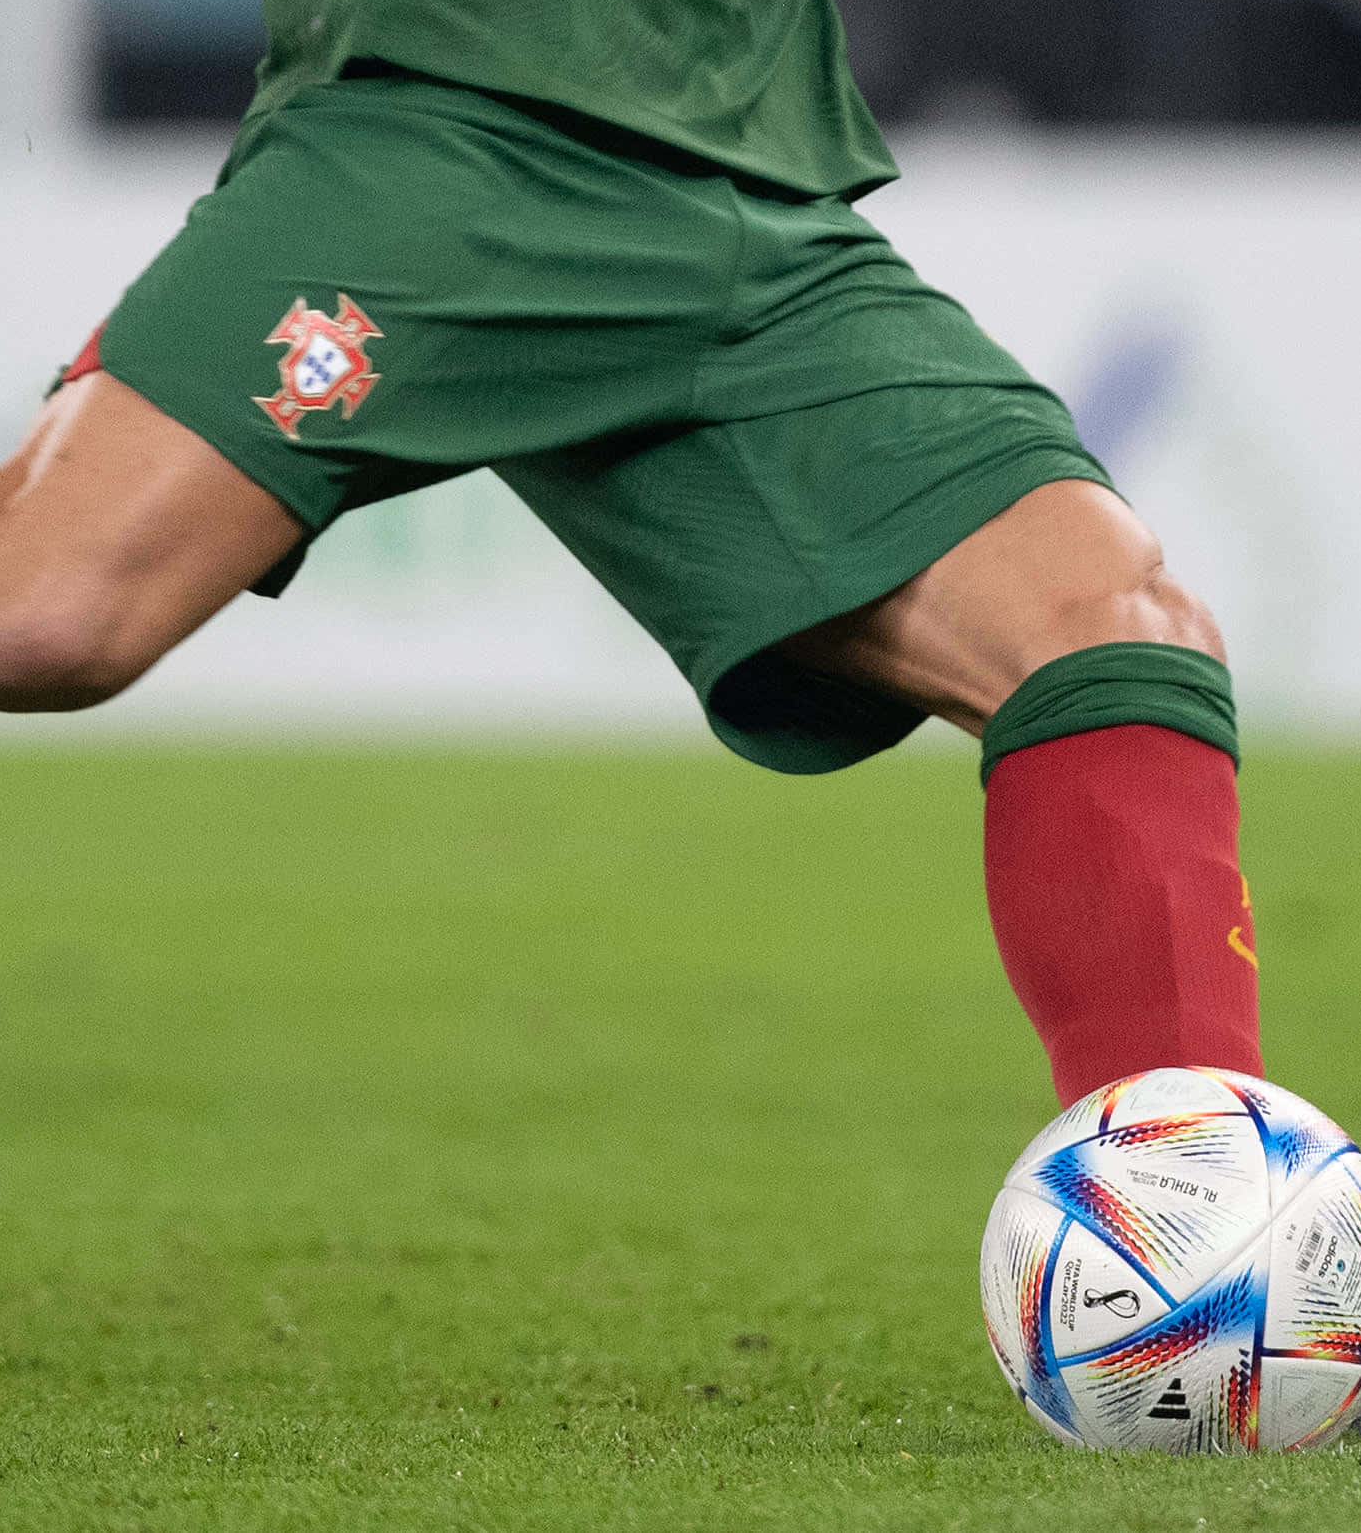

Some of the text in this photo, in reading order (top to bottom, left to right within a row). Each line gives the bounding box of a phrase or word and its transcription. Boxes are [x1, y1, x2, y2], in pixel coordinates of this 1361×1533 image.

[1159, 1175, 1219, 1203] AL RIHLA
[1319, 1235, 1338, 1278] adidas
[1067, 1258, 1082, 1332] FIFA WORLD CUP
